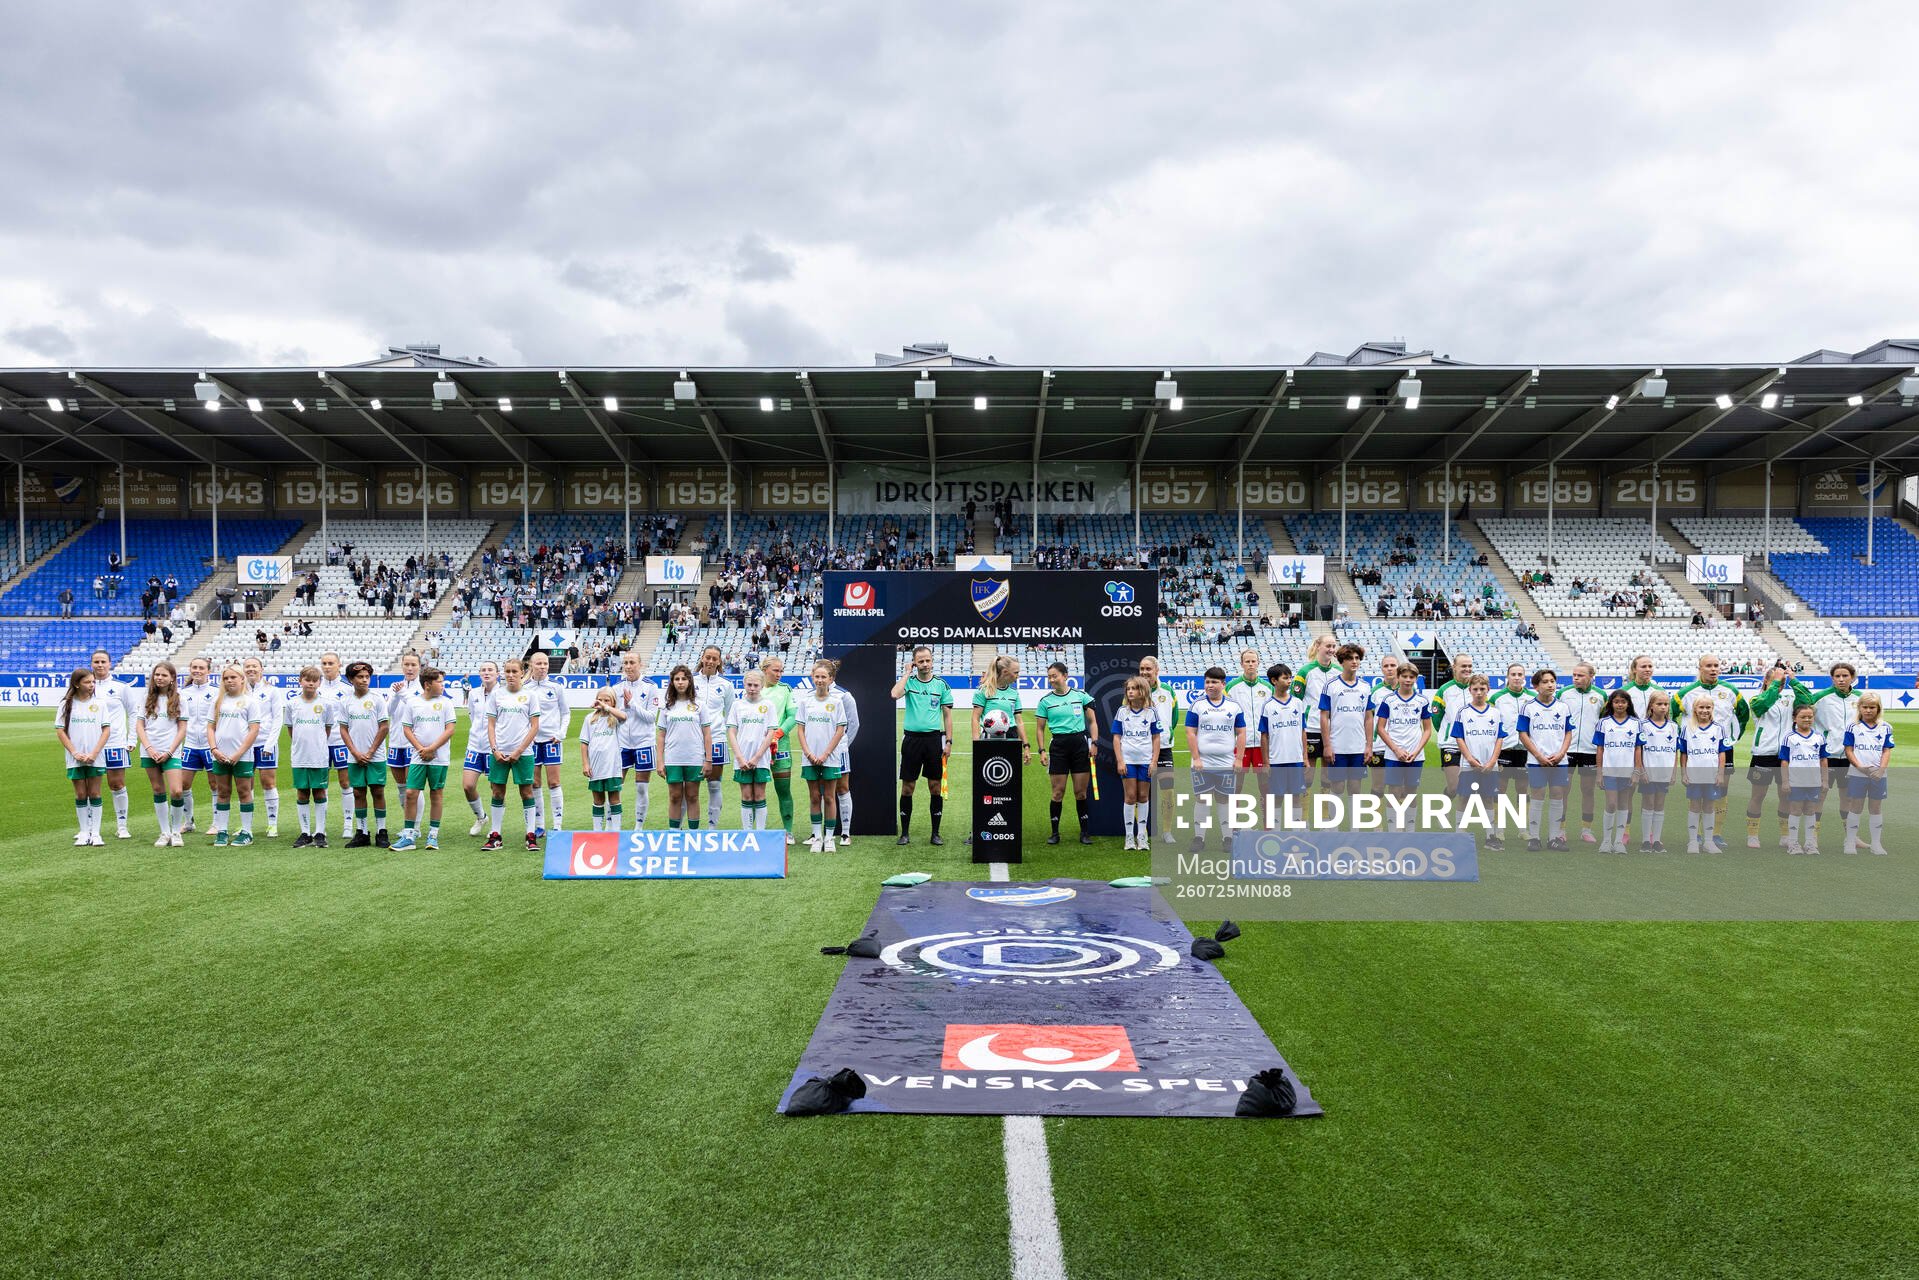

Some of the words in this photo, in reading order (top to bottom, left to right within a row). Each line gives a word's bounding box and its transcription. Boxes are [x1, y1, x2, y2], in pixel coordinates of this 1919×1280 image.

[192, 482, 264, 504] 1943
[282, 482, 358, 504] 1945
[382, 482, 454, 504] 1946
[477, 482, 546, 505] 1947
[571, 482, 642, 505] 1948
[665, 482, 736, 505] 1952
[759, 482, 831, 505] 1956
[876, 481, 1094, 502] IDROTTSPARKEN
[1140, 481, 1208, 504] 1957
[1232, 481, 1305, 504] 1960
[1328, 481, 1401, 504] 1962
[1424, 481, 1497, 504] 1963
[1520, 481, 1592, 504] 1989
[1617, 480, 1696, 502] 2015
[1815, 482, 1848, 490] adidas
[663, 558, 684, 580] liv
[1282, 559, 1306, 578] ett
[1702, 556, 1728, 582] lag
[975, 586, 990, 594] IFK
[833, 608, 866, 617] SVENSKA
[867, 609, 885, 617] SPEL
[1101, 605, 1142, 617] OBOS
[898, 627, 940, 638] OBOS
[943, 627, 1083, 638] DAMALLSVENSKAN
[1090, 658, 1129, 676] OBOS
[1200, 724, 1232, 732] HOLMEN
[1272, 720, 1299, 729] HOLME
[1532, 723, 1564, 731] HOLMEN
[1791, 753, 1820, 761] HOLME
[1854, 743, 1883, 751] HOLME
[630, 832, 760, 853] SVENSKA
[628, 856, 697, 875] SPEL
[1330, 846, 1455, 878] OBOS
[977, 928, 1078, 938] OBOS
[863, 1073, 1103, 1092] VENSKA
